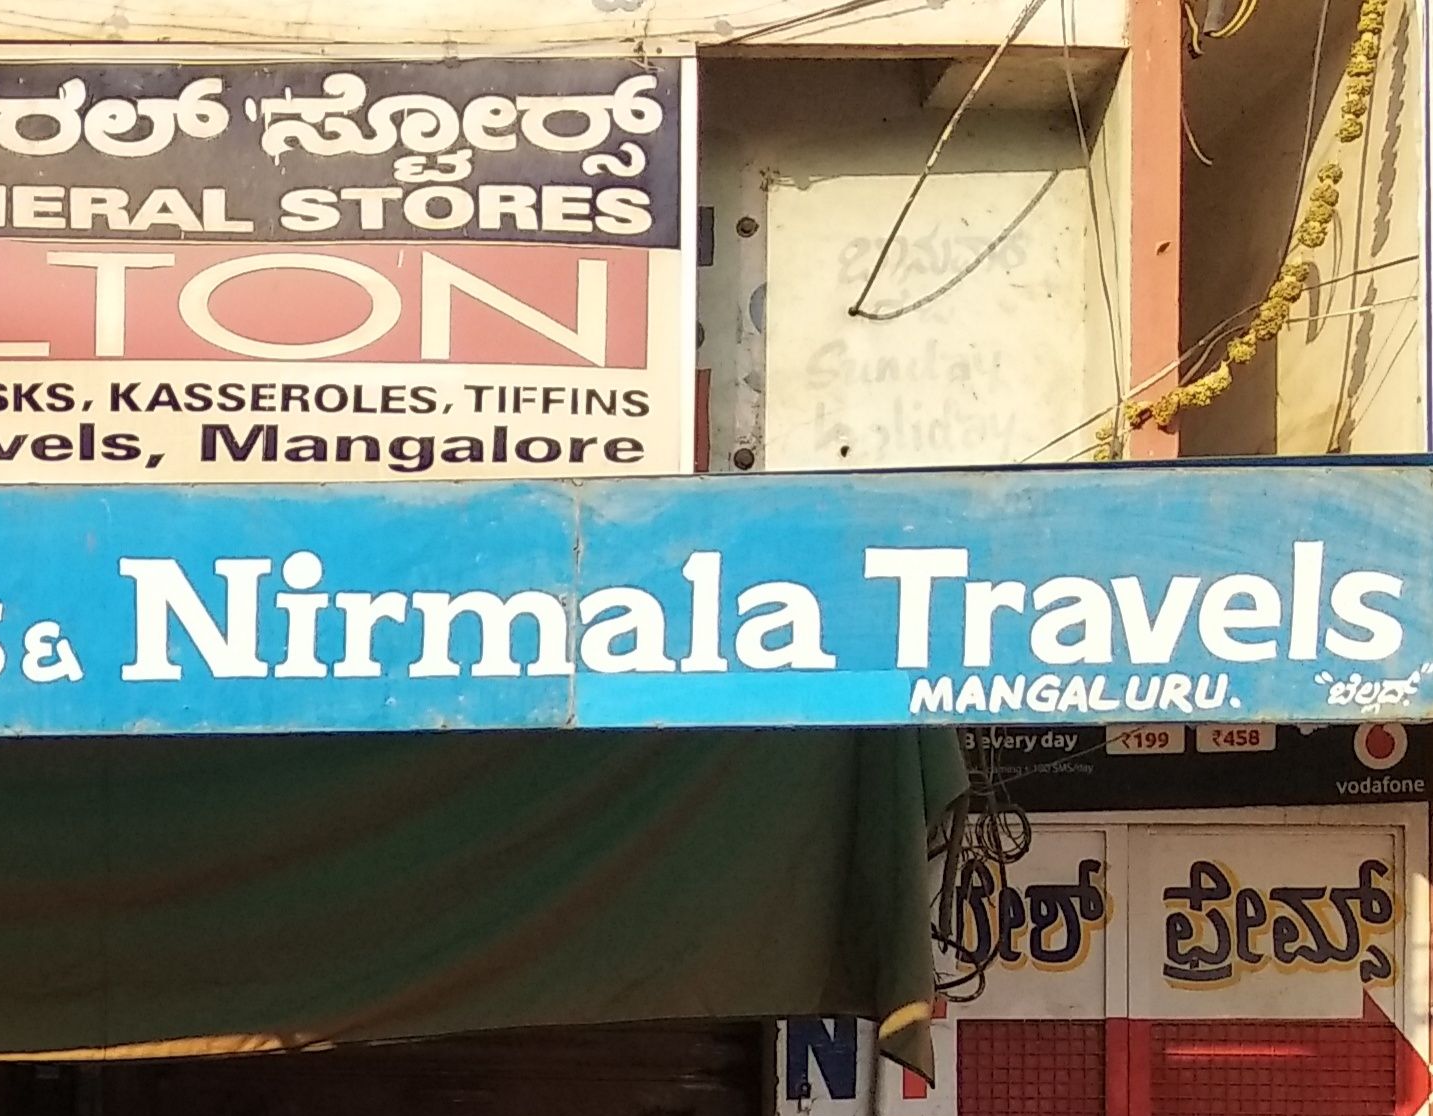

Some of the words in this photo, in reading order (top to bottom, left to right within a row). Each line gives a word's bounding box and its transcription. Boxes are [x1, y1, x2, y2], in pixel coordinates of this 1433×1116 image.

[279, 184, 653, 236] STORES
[110, 382, 452, 417] KASSEROLES,
[470, 383, 650, 418] TIFFINS
[200, 422, 646, 473] Mangalore
[21, 622, 83, 684] &
[118, 550, 838, 681] Nirmala
[864, 540, 1404, 668] Travels
[909, 674, 1242, 714] MANGALURU.
[982, 732, 1038, 753] every
[1040, 729, 1079, 752] day
[1212, 729, 1260, 747] ₹458
[1335, 775, 1425, 795] vodafone
